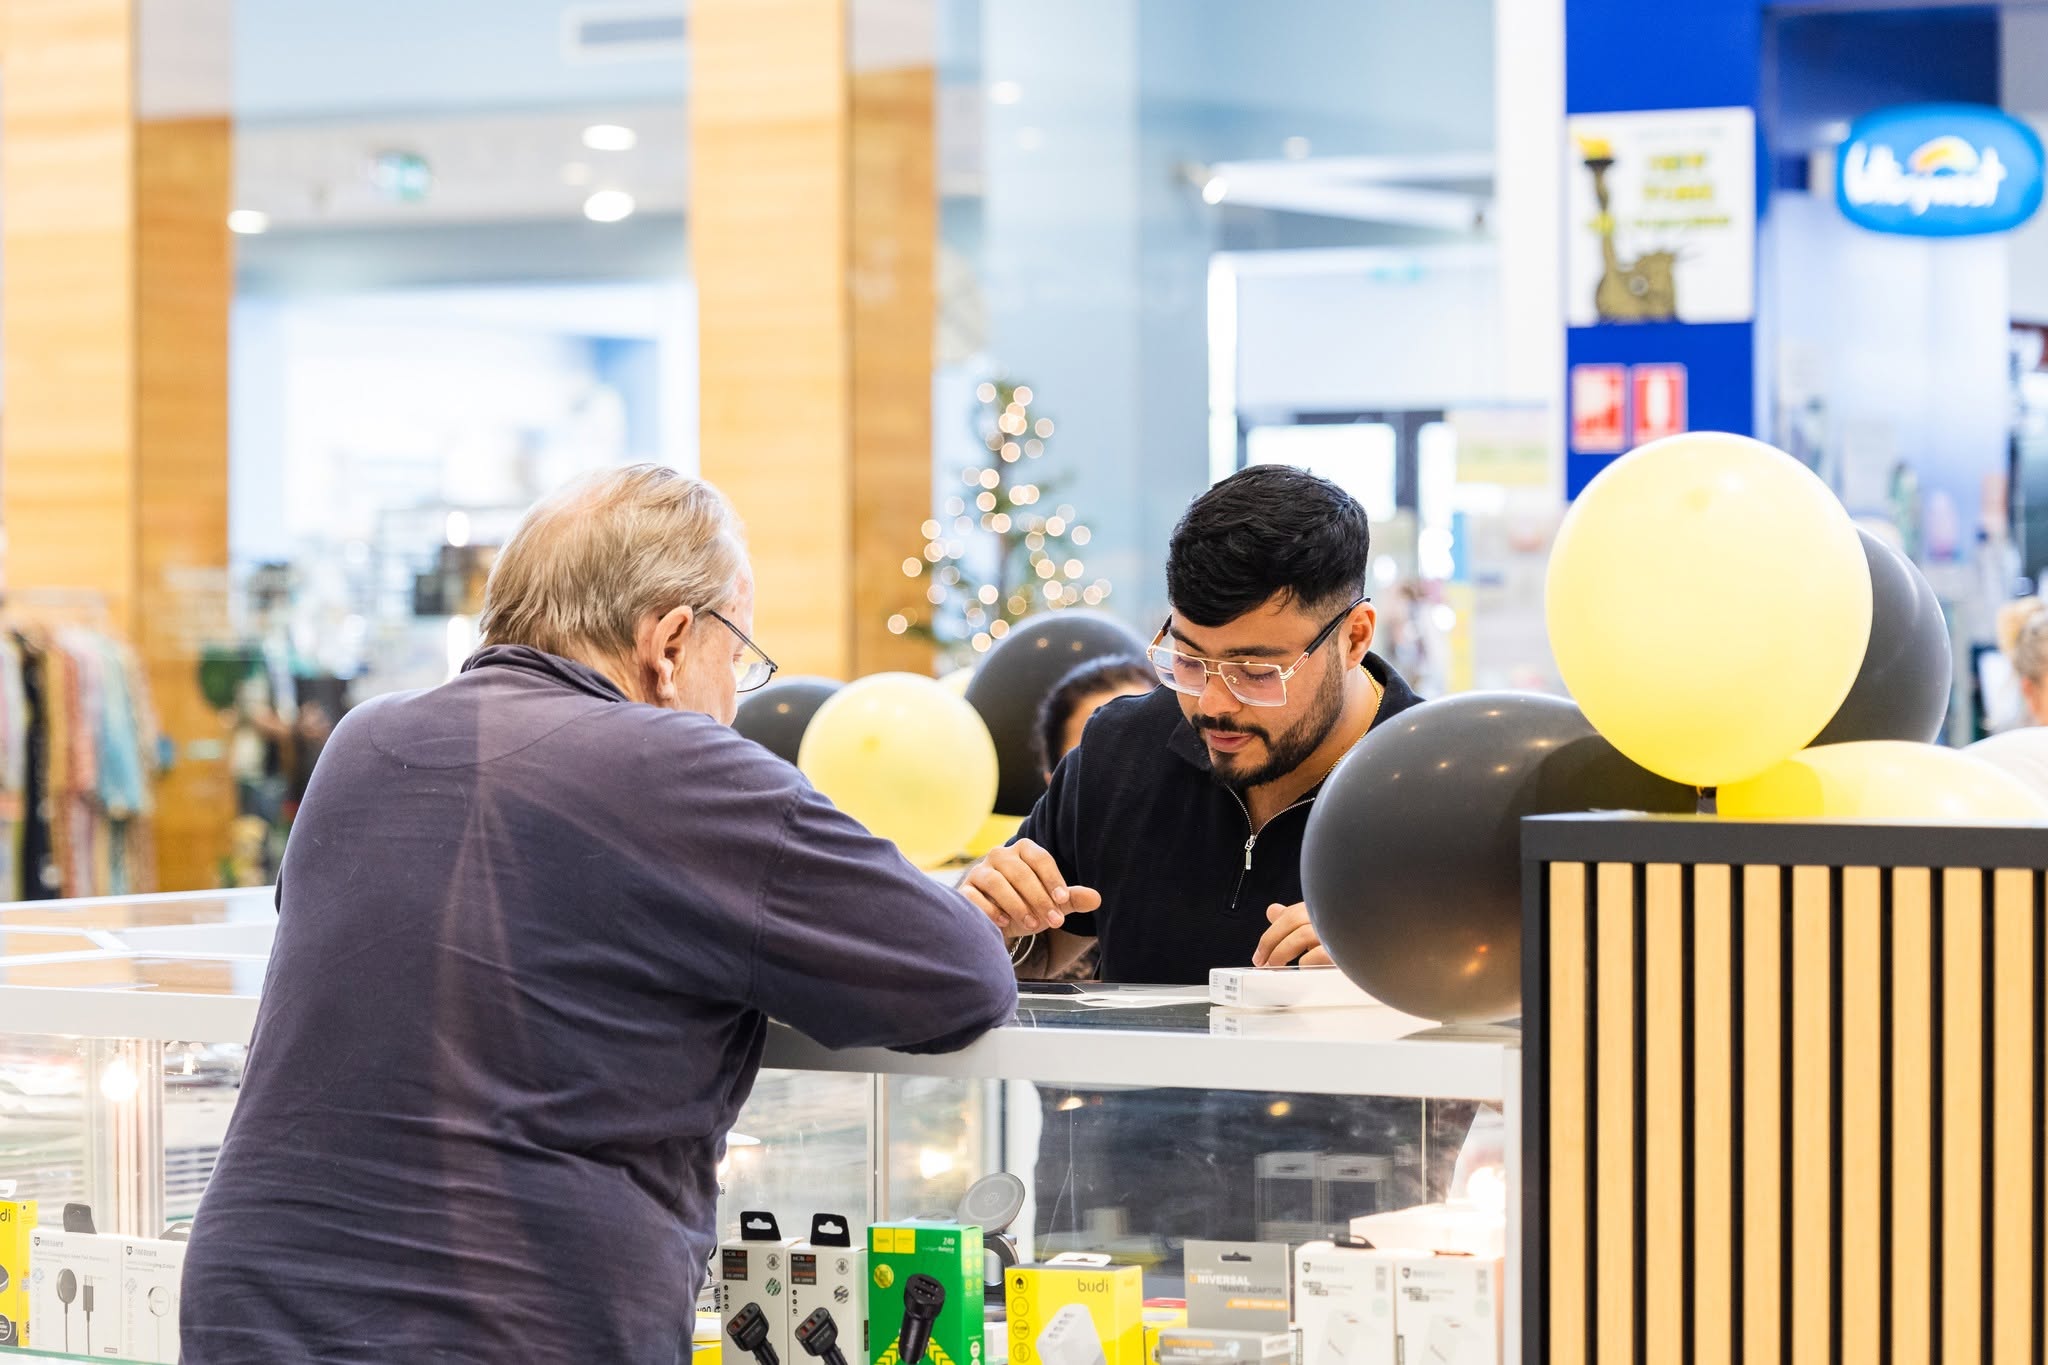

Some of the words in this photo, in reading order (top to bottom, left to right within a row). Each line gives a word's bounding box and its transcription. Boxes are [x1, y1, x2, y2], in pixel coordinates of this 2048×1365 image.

[1077, 1278, 1109, 1293] budi
[1189, 1273, 1251, 1286] UNIVERSAL
[1218, 1285, 1246, 1294] TRAVEL
